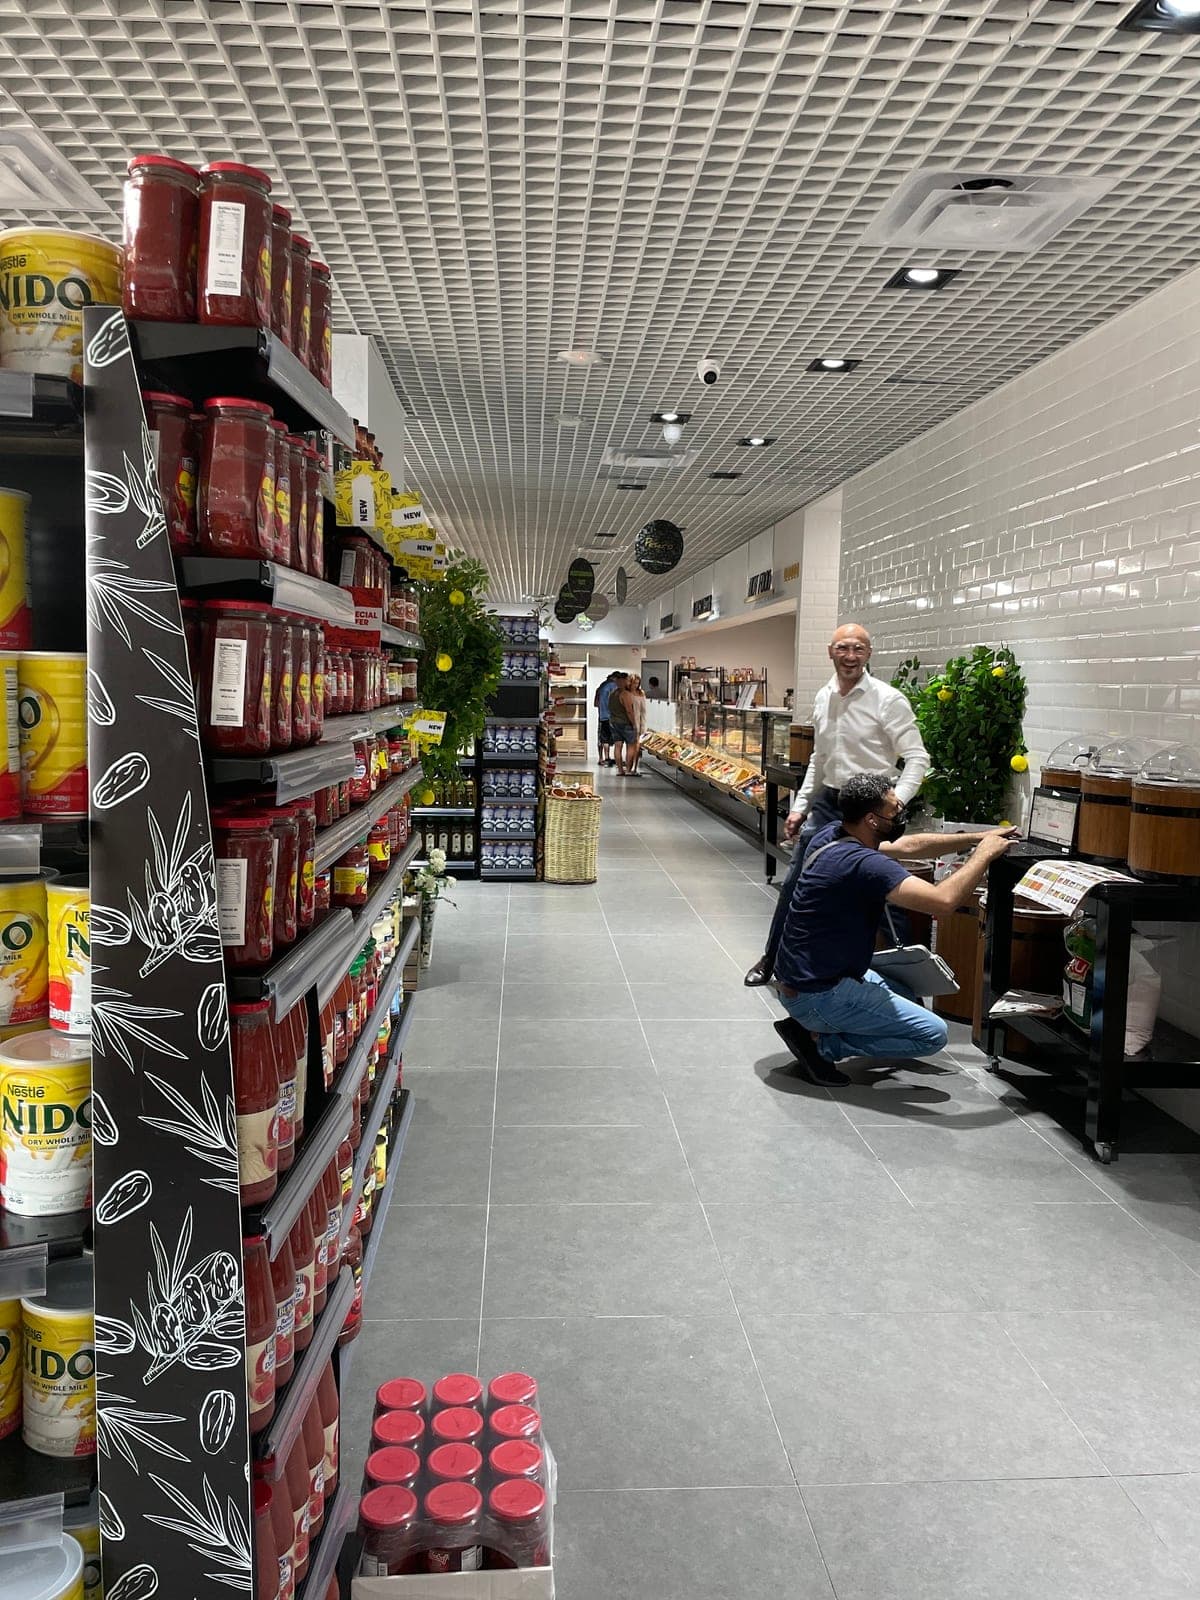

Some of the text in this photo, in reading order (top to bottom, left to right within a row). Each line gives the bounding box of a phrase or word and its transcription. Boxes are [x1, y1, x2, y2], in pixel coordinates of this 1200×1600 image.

[27, 312, 56, 320] WHOLE
[359, 499, 368, 522] NEW
[403, 510, 422, 521] NEW
[416, 543, 433, 552] NEW
[355, 610, 378, 619] ECIAL
[428, 723, 443, 731] NEW
[46, 1136, 76, 1146] WHOLE
[41, 1383, 66, 1392] WHOLE
